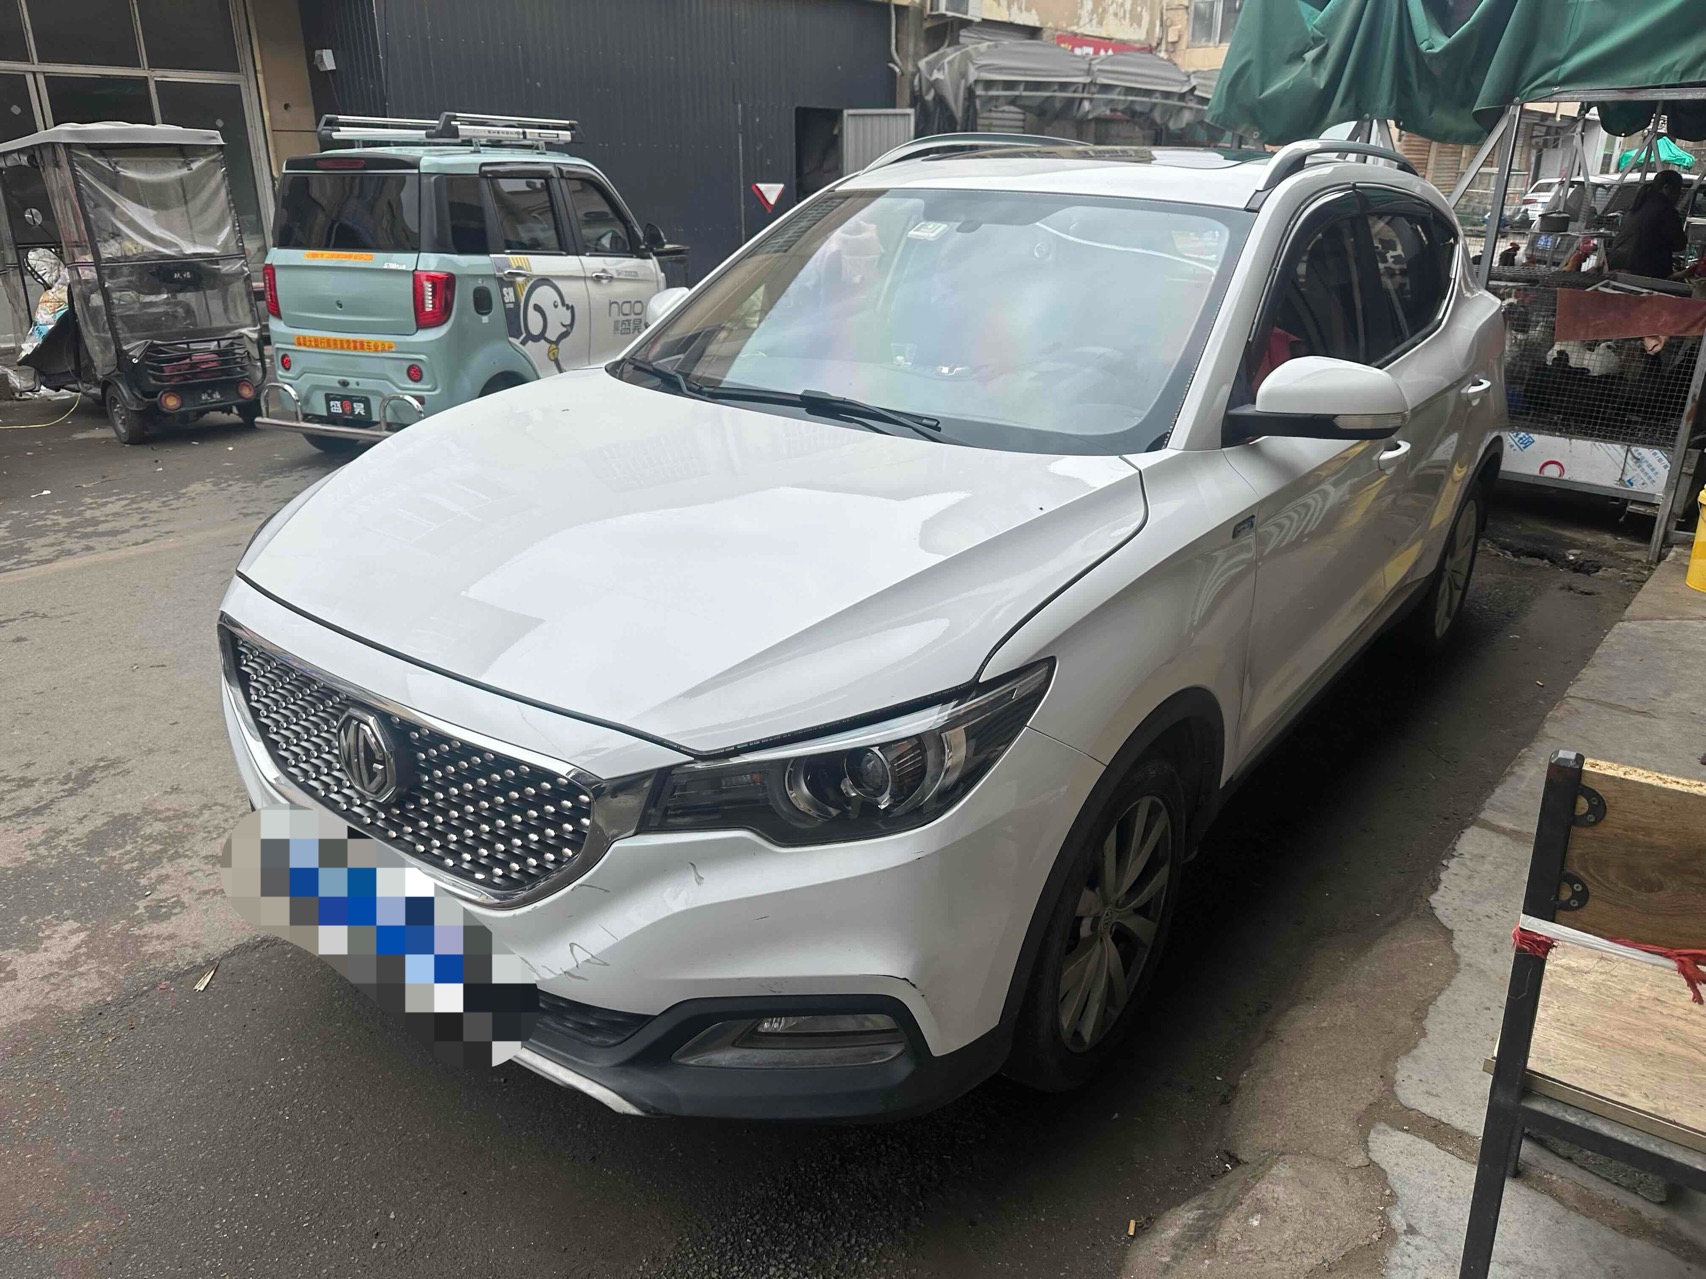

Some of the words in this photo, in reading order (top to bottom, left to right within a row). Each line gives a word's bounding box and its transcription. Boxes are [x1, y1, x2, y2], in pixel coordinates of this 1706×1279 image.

[503, 287, 515, 303] SH
[608, 299, 645, 318] hao
[339, 716, 388, 797] MG
